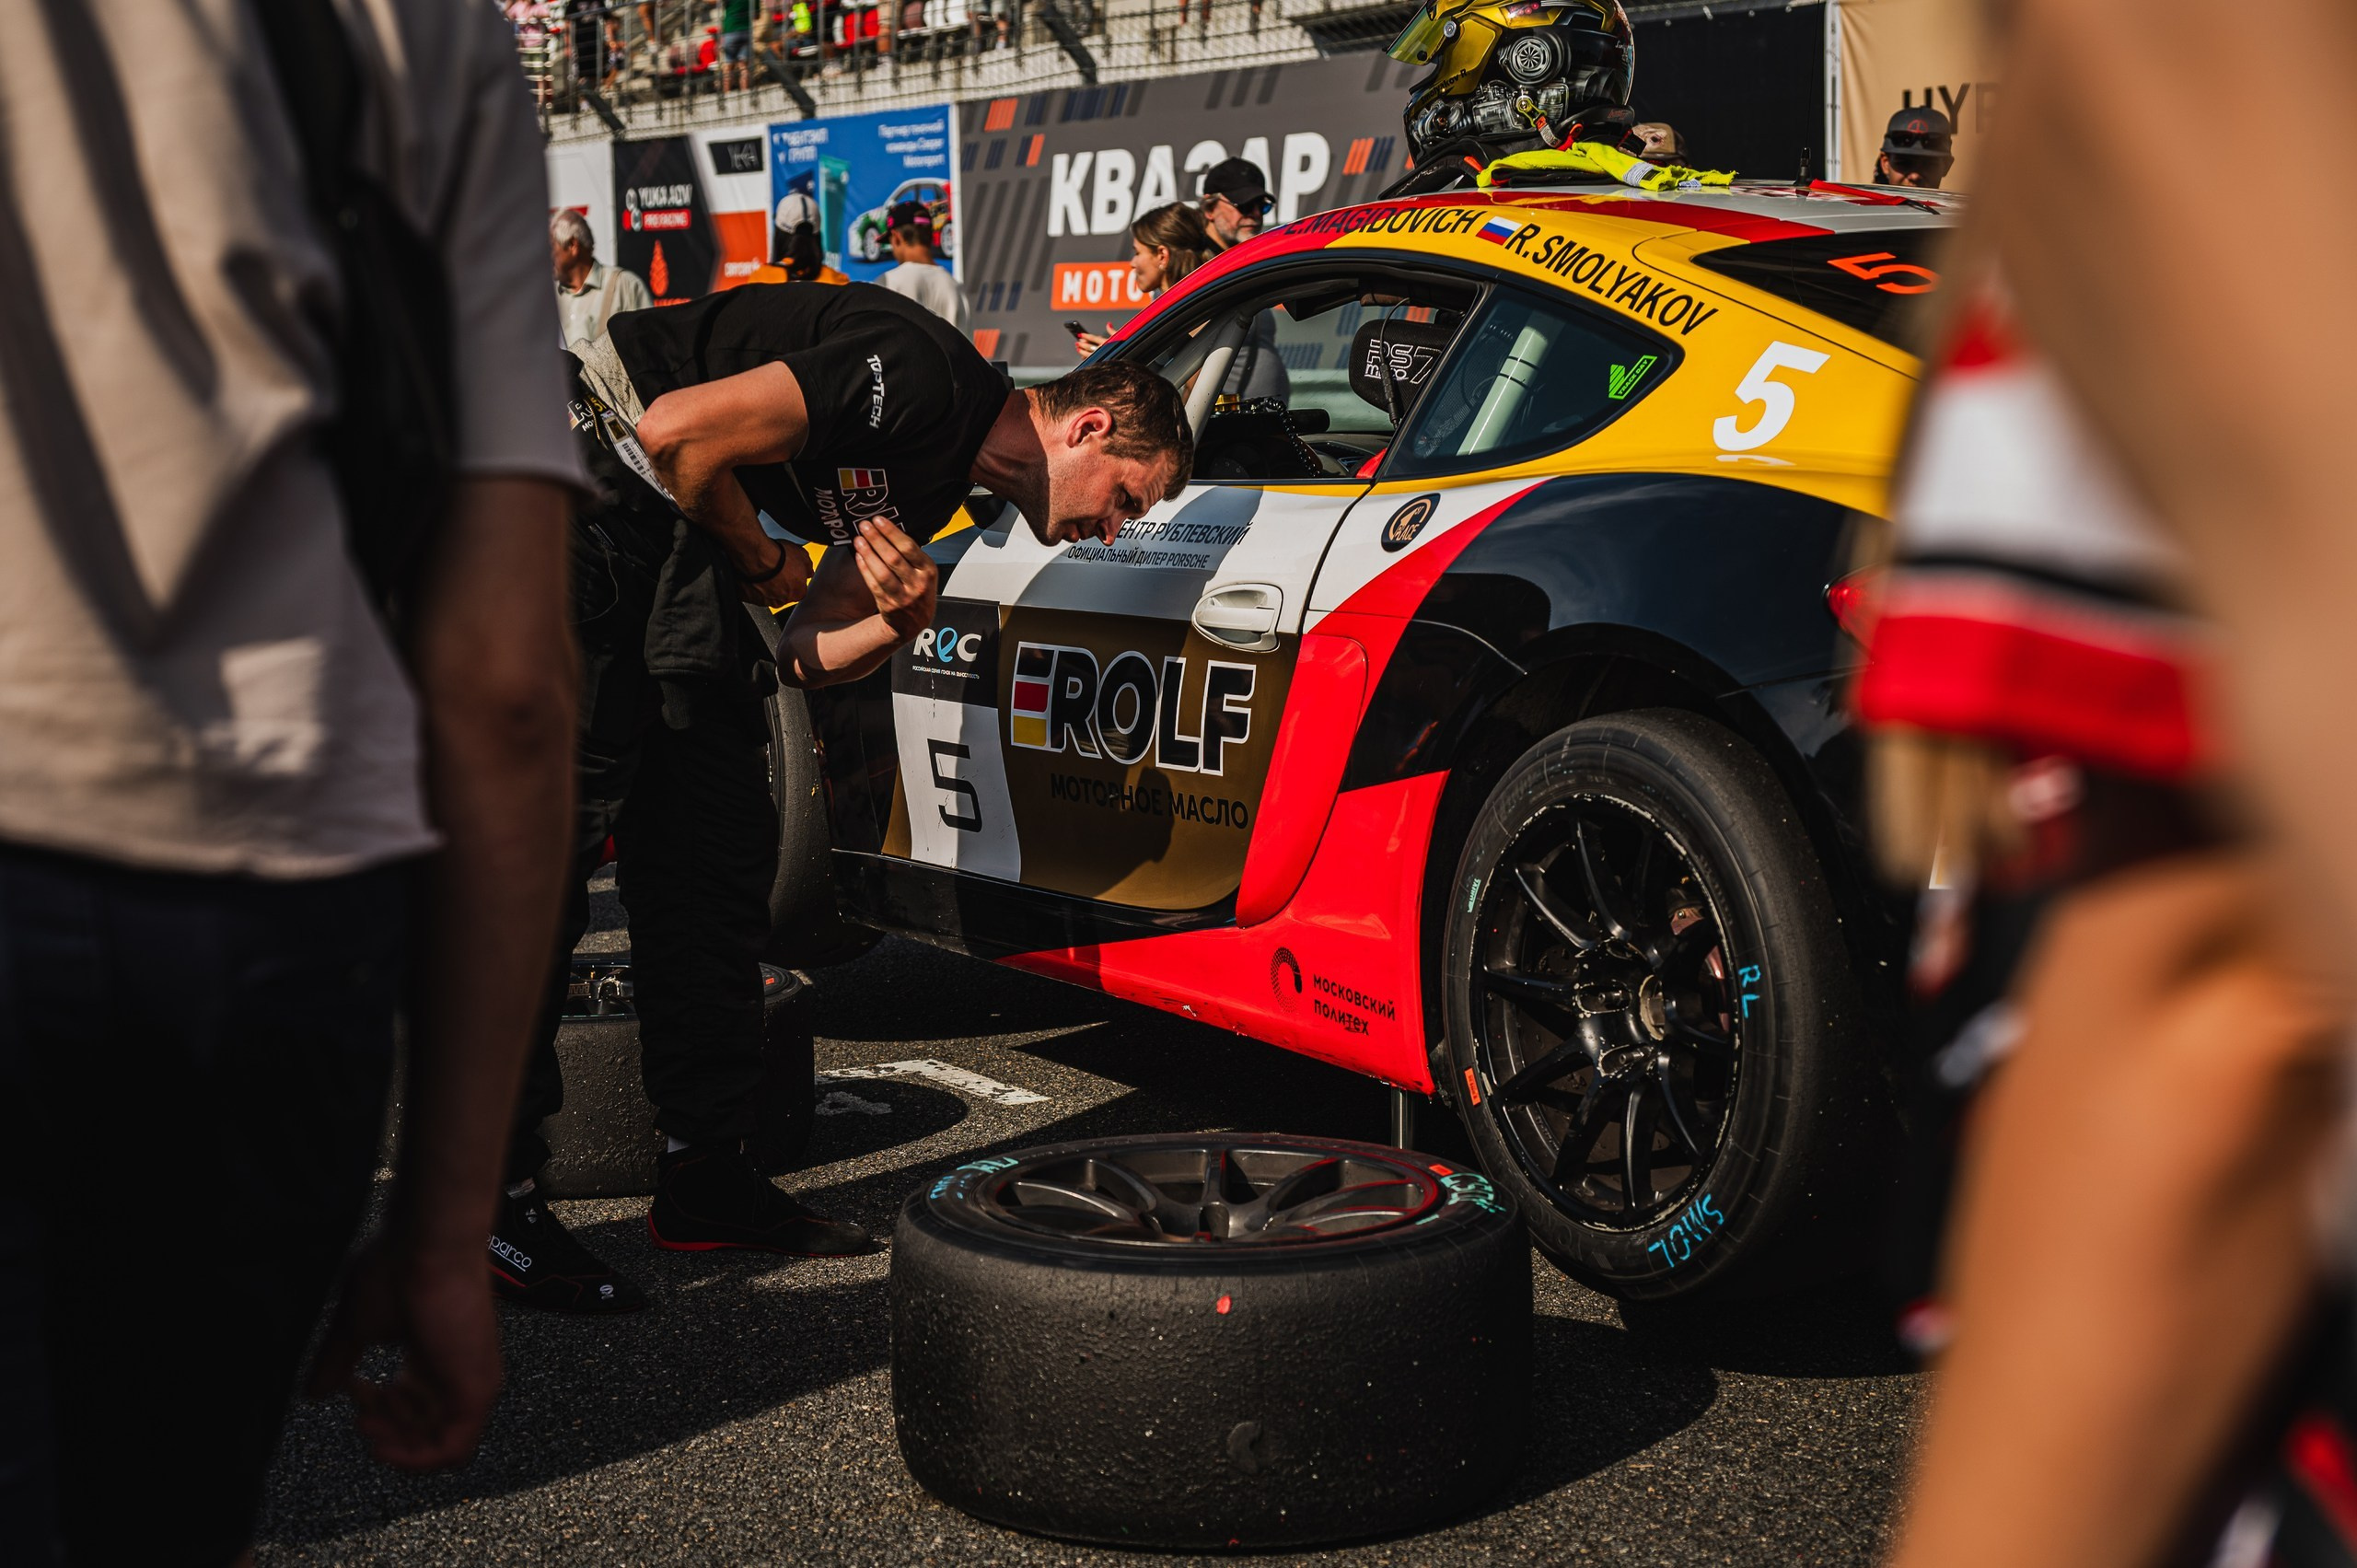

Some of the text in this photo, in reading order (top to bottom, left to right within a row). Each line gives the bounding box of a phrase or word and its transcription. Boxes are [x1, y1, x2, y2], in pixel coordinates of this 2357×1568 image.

[1062, 269, 1155, 304] МОТО
[1504, 223, 1719, 337] R.SMOLYAKOV
[1827, 252, 1942, 295] 5
[1618, 359, 1648, 395] TRACK DAY
[1713, 340, 1831, 452] 5
[1117, 520, 1254, 546] ЕНТР РУБЛЕВСКИЙ
[1068, 546, 1211, 568] ОФИЦИАЛЬНЫЙ ДИЛЕР PORSCHE
[1048, 645, 1257, 776] ROLF
[926, 738, 983, 833] 5
[1050, 772, 1249, 830] МОТОРНОЕ МАСЛО
[487, 1232, 532, 1270] parco
